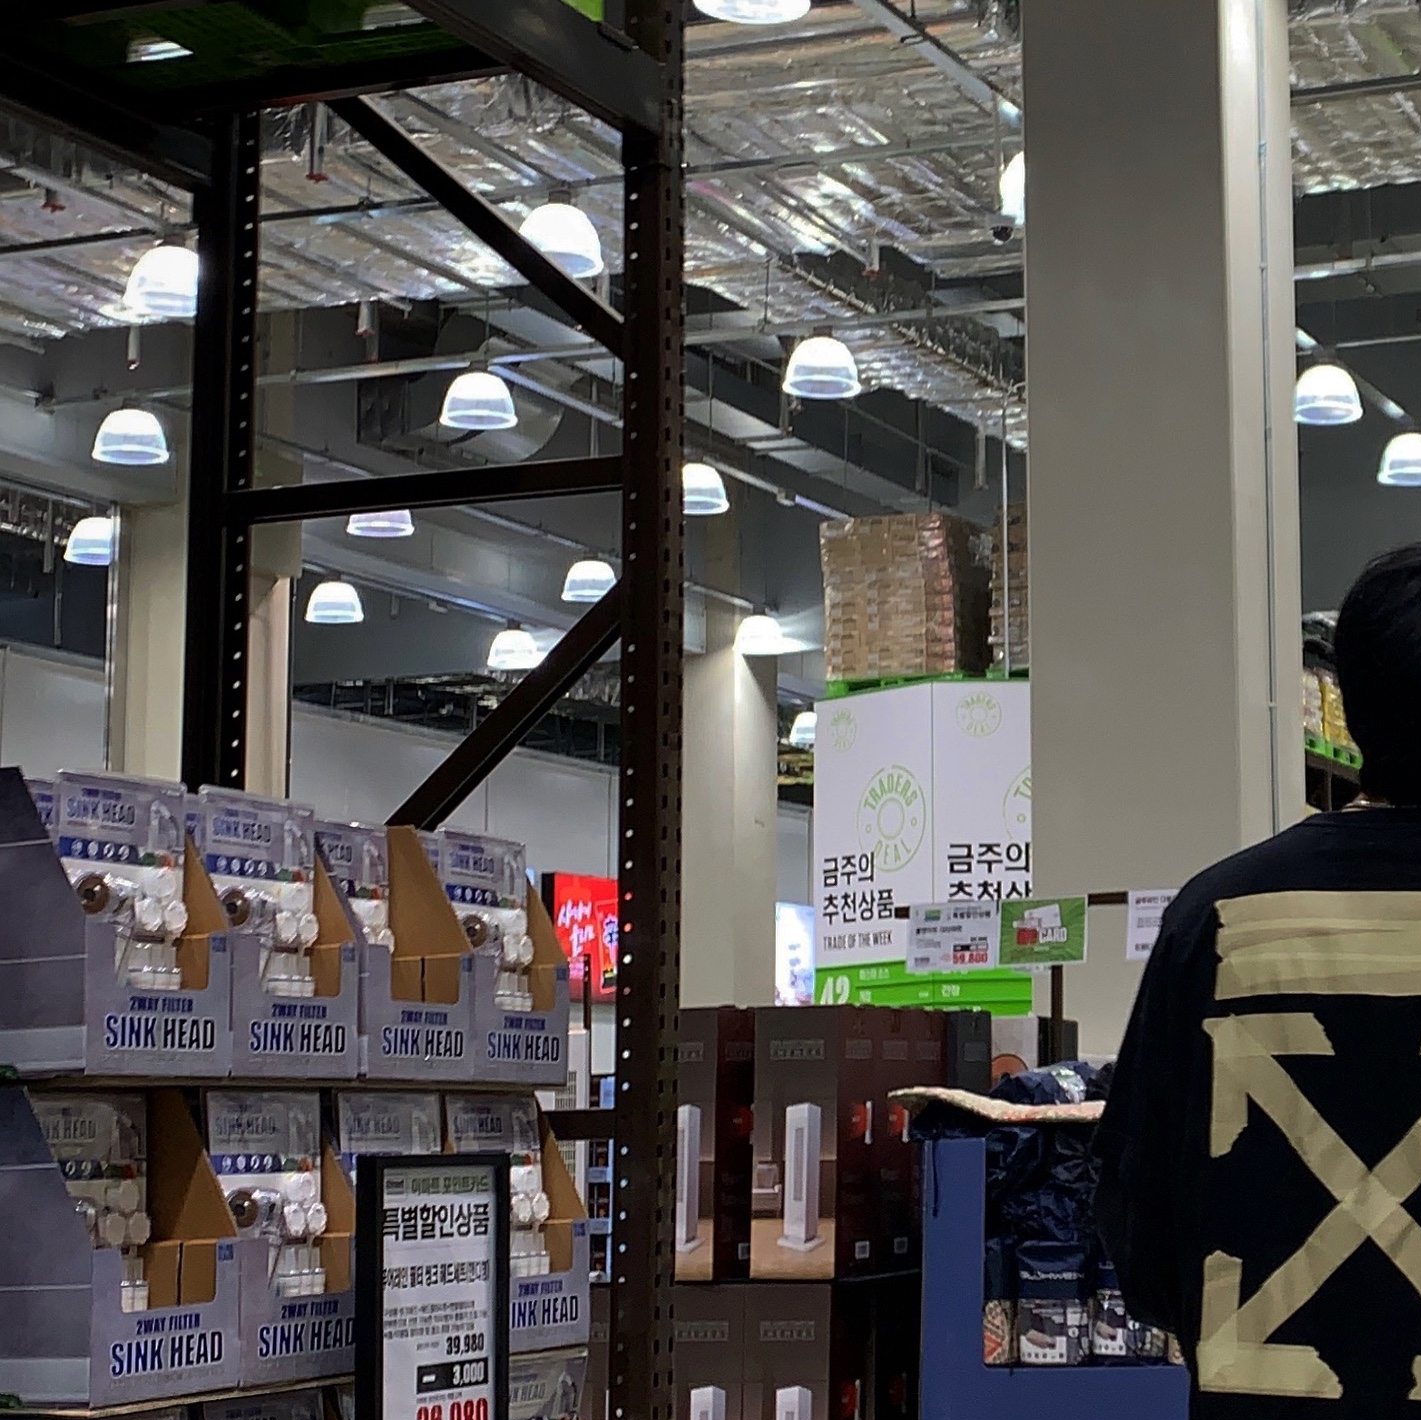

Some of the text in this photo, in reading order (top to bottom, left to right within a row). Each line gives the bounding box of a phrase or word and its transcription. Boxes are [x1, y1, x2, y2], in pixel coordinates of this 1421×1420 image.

[864, 773, 919, 811] TRADERS
[823, 852, 875, 887] 금주의
[947, 841, 1031, 875] 금주의
[823, 889, 894, 926] 추천상품
[105, 1015, 216, 1050] SINK HEAD
[250, 1021, 346, 1054] SINK HEAD
[382, 1027, 464, 1058] SINK HEAD
[487, 1032, 560, 1062] SINK HEAD
[382, 1202, 490, 1241] 특별할인상품
[136, 1313, 201, 1335] 2WAY FILTER
[511, 1300, 537, 1329] INK
[541, 1295, 579, 1325] HEAD
[111, 1330, 223, 1378] SINK HEAD
[259, 1320, 306, 1358] SINK
[445, 1332, 485, 1356] 39,980
[452, 1361, 485, 1386] 3,000
